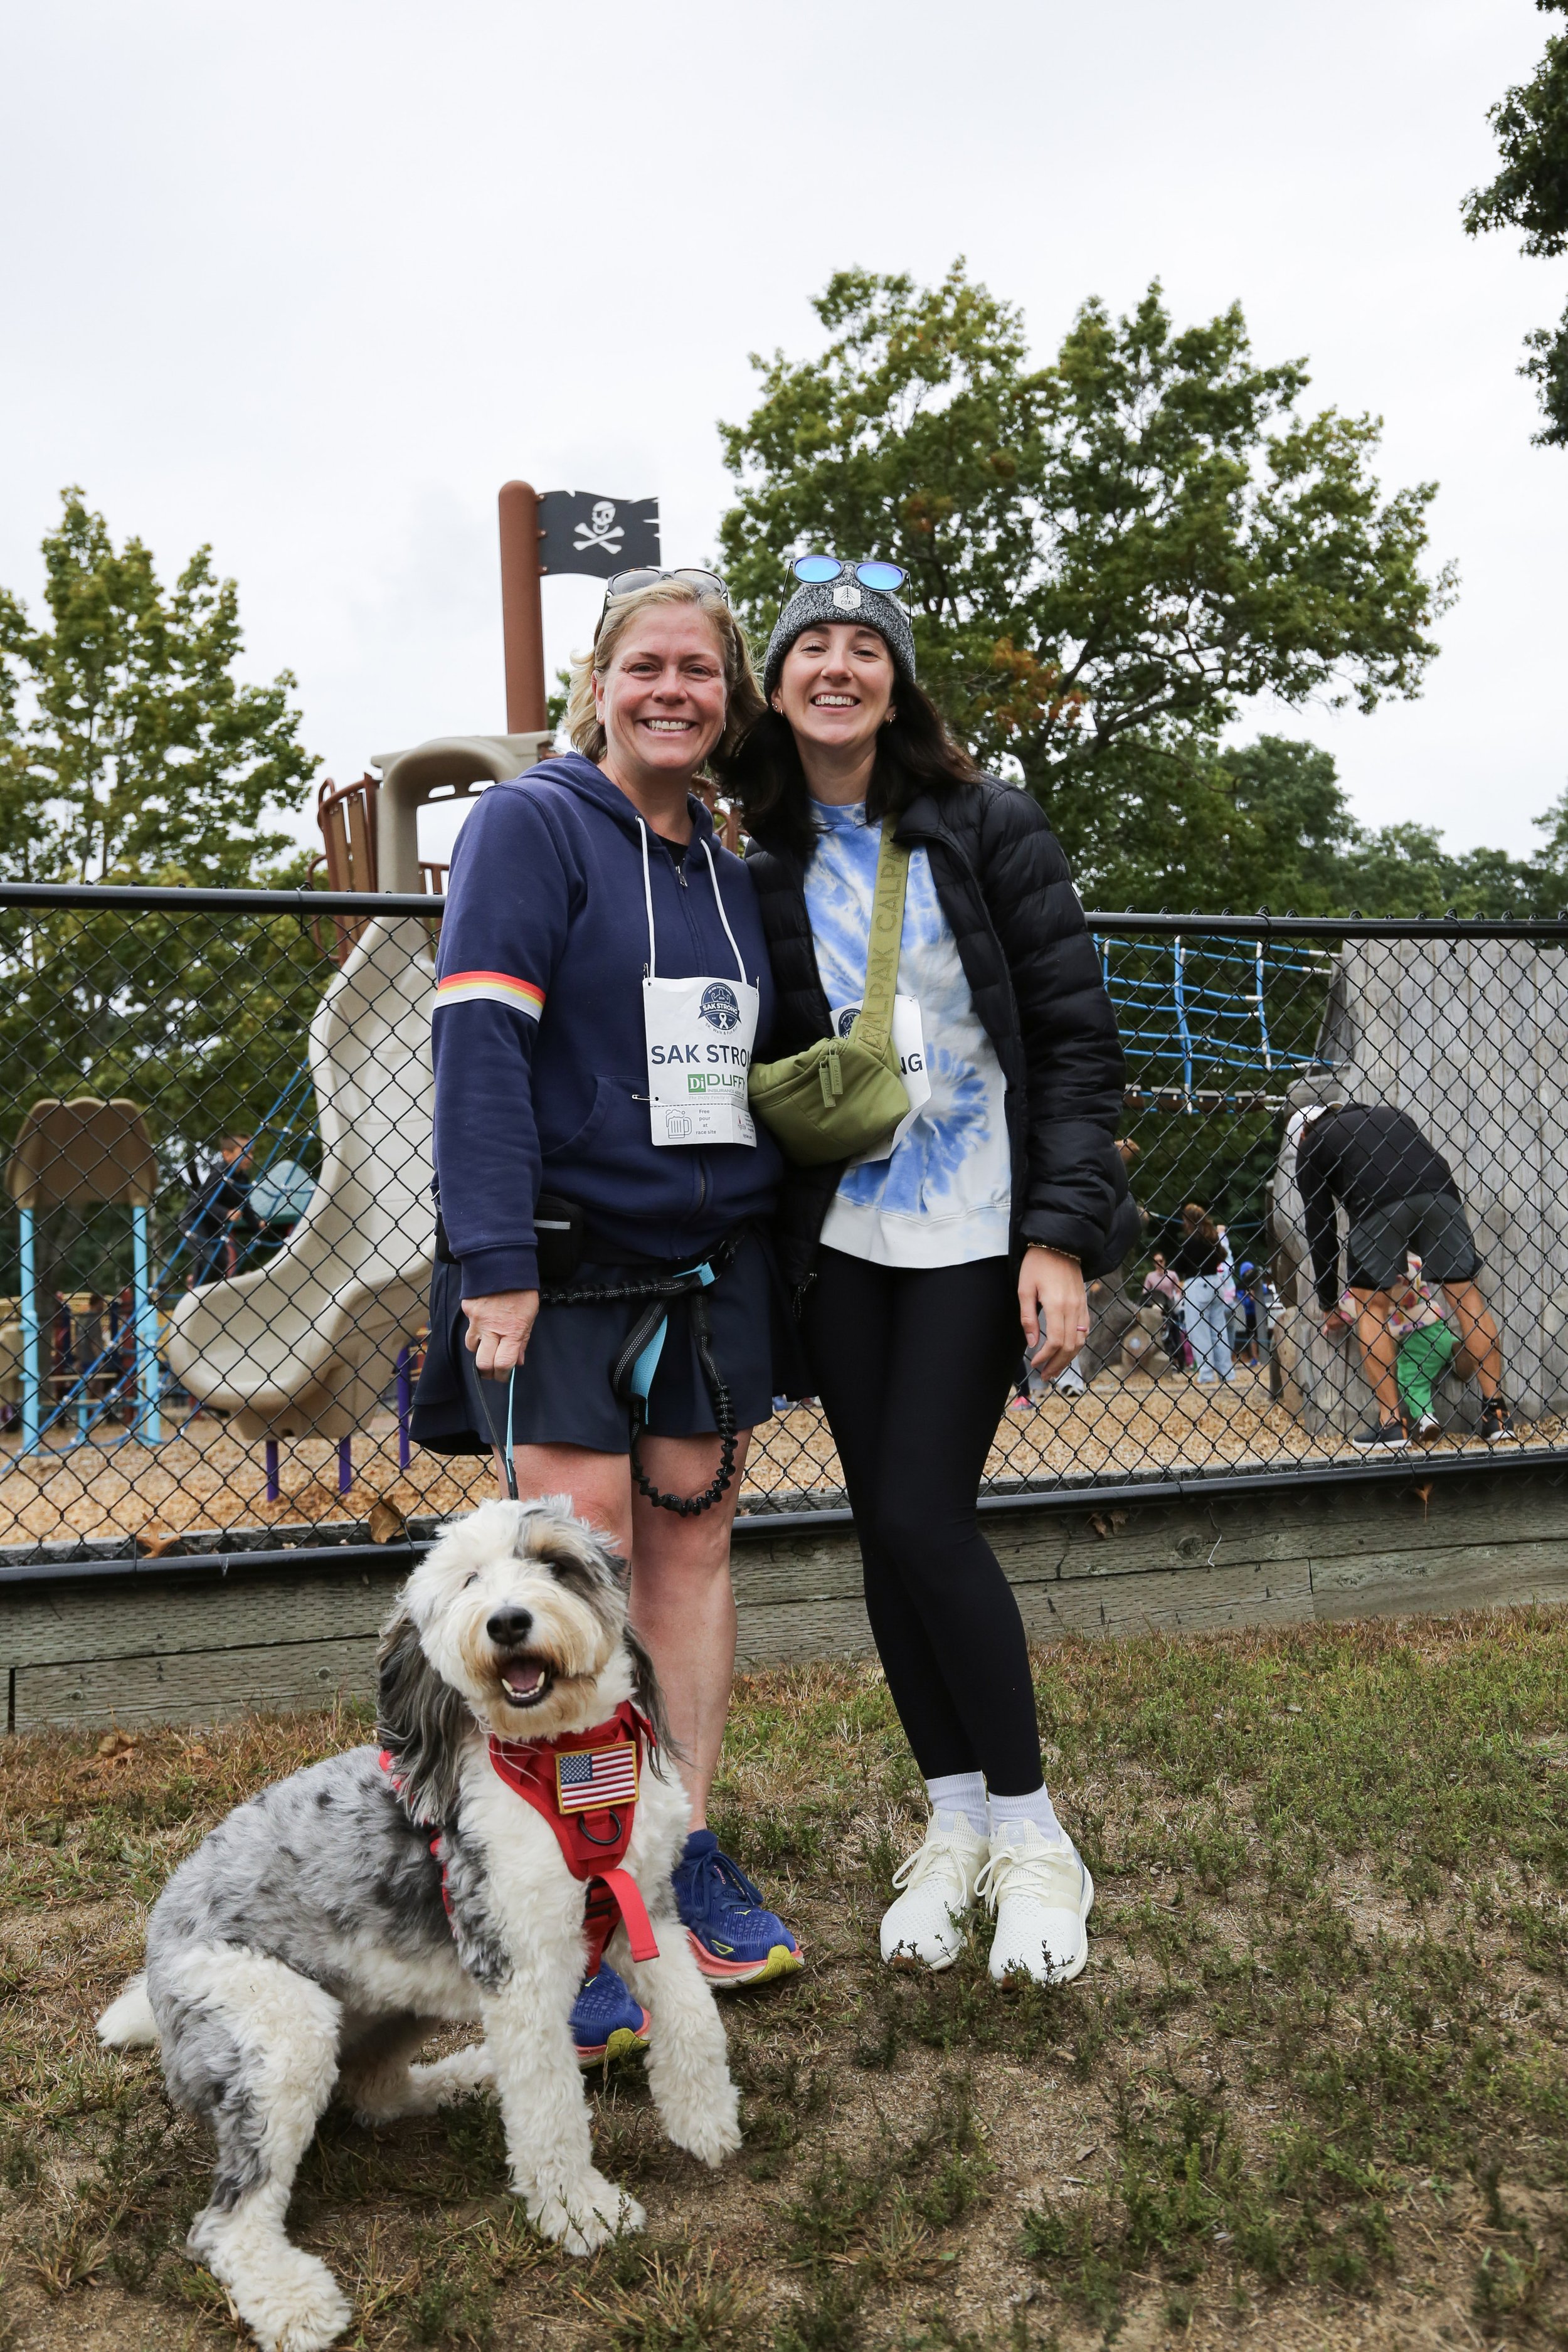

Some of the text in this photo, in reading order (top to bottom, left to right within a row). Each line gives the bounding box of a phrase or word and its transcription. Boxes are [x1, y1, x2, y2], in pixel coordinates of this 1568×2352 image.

[702, 1003, 738, 1014] SAK STRONG
[651, 1044, 701, 1064] SAK
[689, 1077, 705, 1089] Di
[706, 1074, 746, 1091] DUFFY
